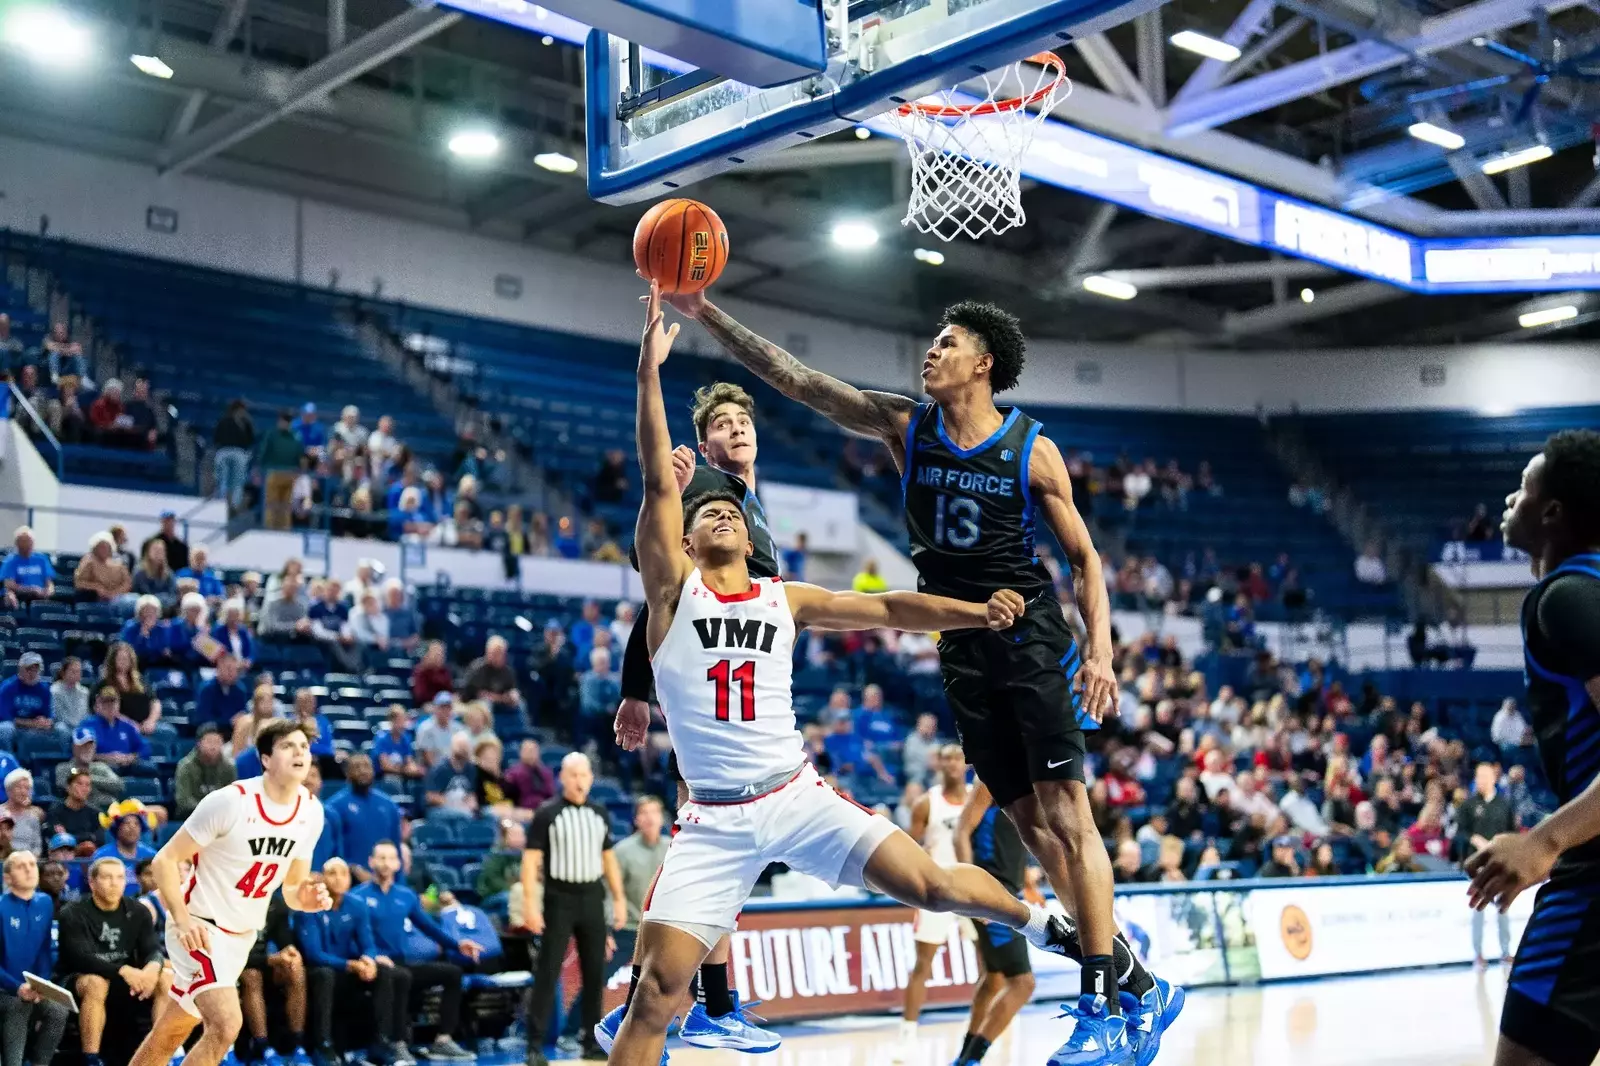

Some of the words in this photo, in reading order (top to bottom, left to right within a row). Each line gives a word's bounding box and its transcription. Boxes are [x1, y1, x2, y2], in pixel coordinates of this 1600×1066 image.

[691, 231, 708, 281] ELITE
[916, 466, 943, 487] AIR
[945, 468, 1015, 497] FORCE
[935, 494, 979, 547] 13
[692, 617, 778, 654] VMI
[707, 659, 756, 721] 11
[248, 837, 296, 858] VMI
[235, 861, 279, 899] 42
[99, 921, 121, 950] AF
[730, 927, 858, 1001] FUTURE
